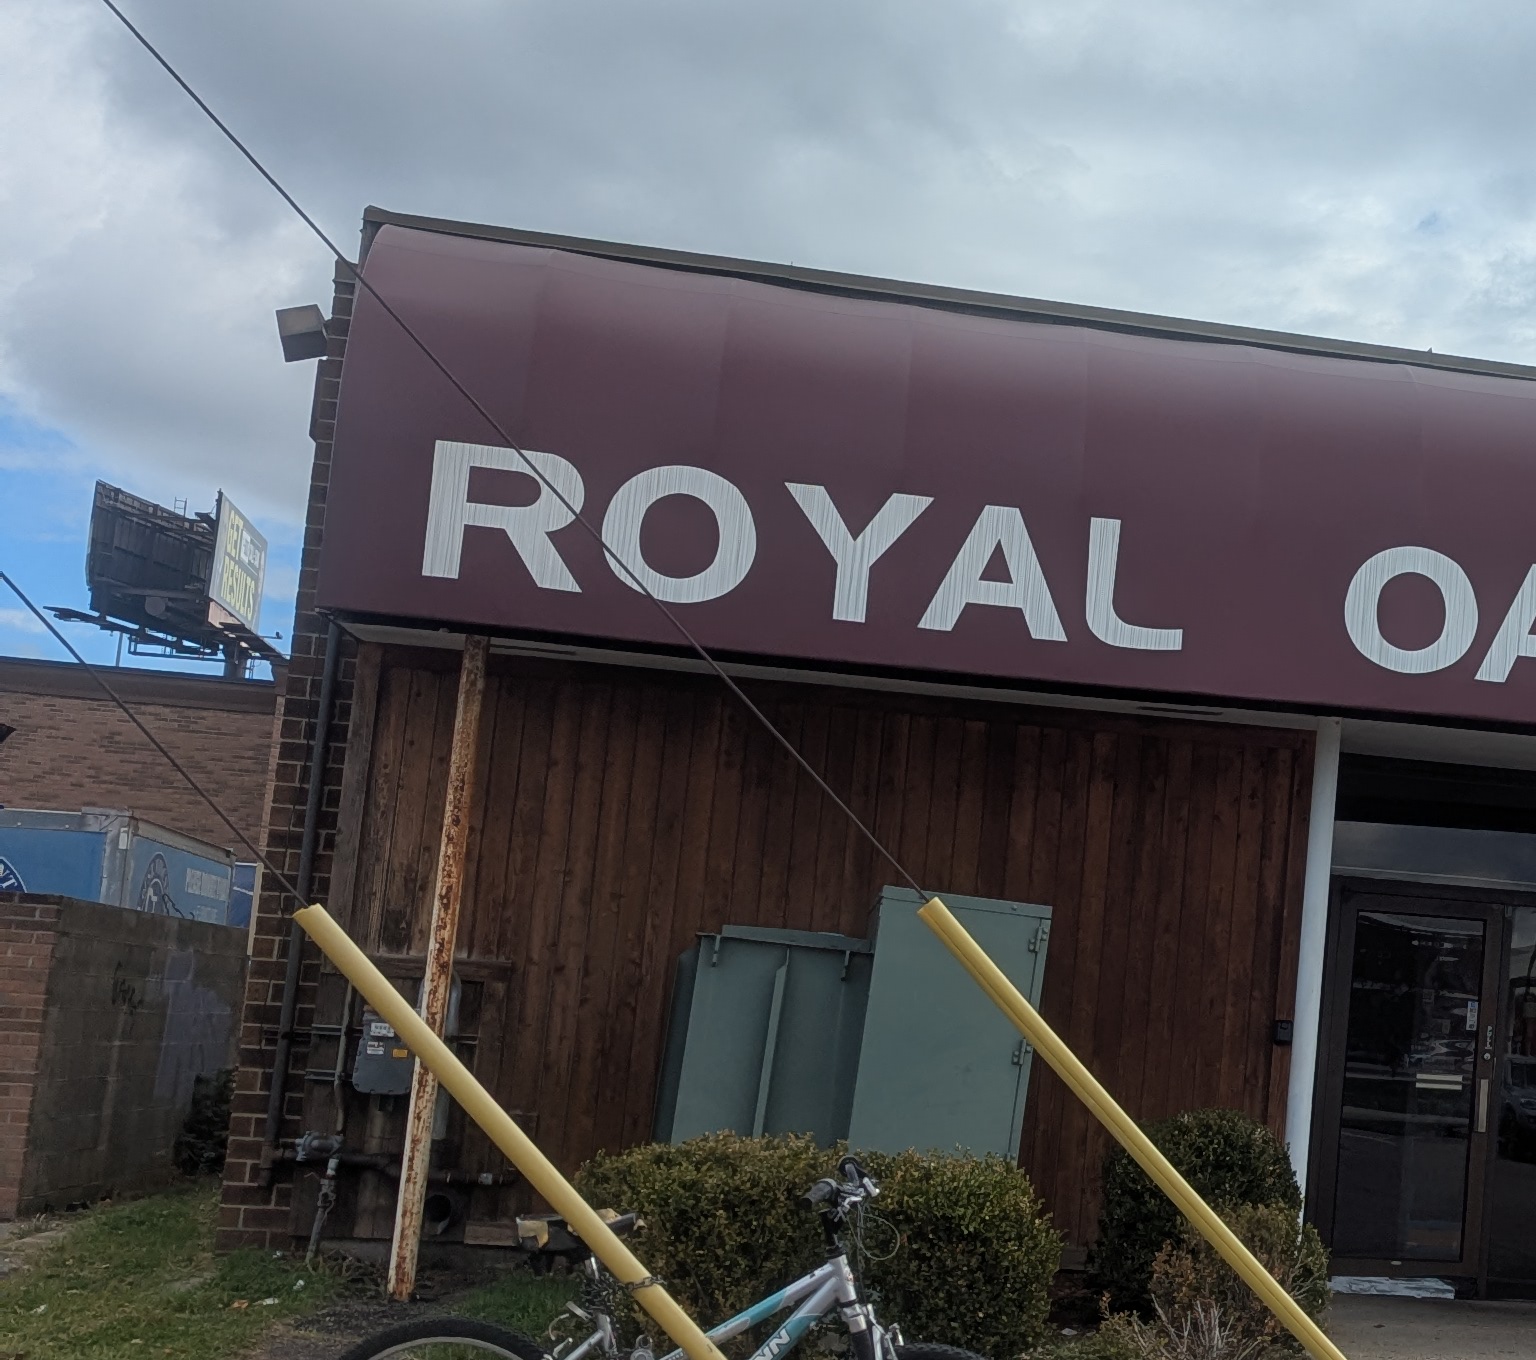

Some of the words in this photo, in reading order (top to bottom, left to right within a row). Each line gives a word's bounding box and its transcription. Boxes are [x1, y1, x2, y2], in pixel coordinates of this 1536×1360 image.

[226, 509, 243, 560] GET
[422, 439, 1184, 652] ROYAL
[221, 555, 255, 621] RESULTS
